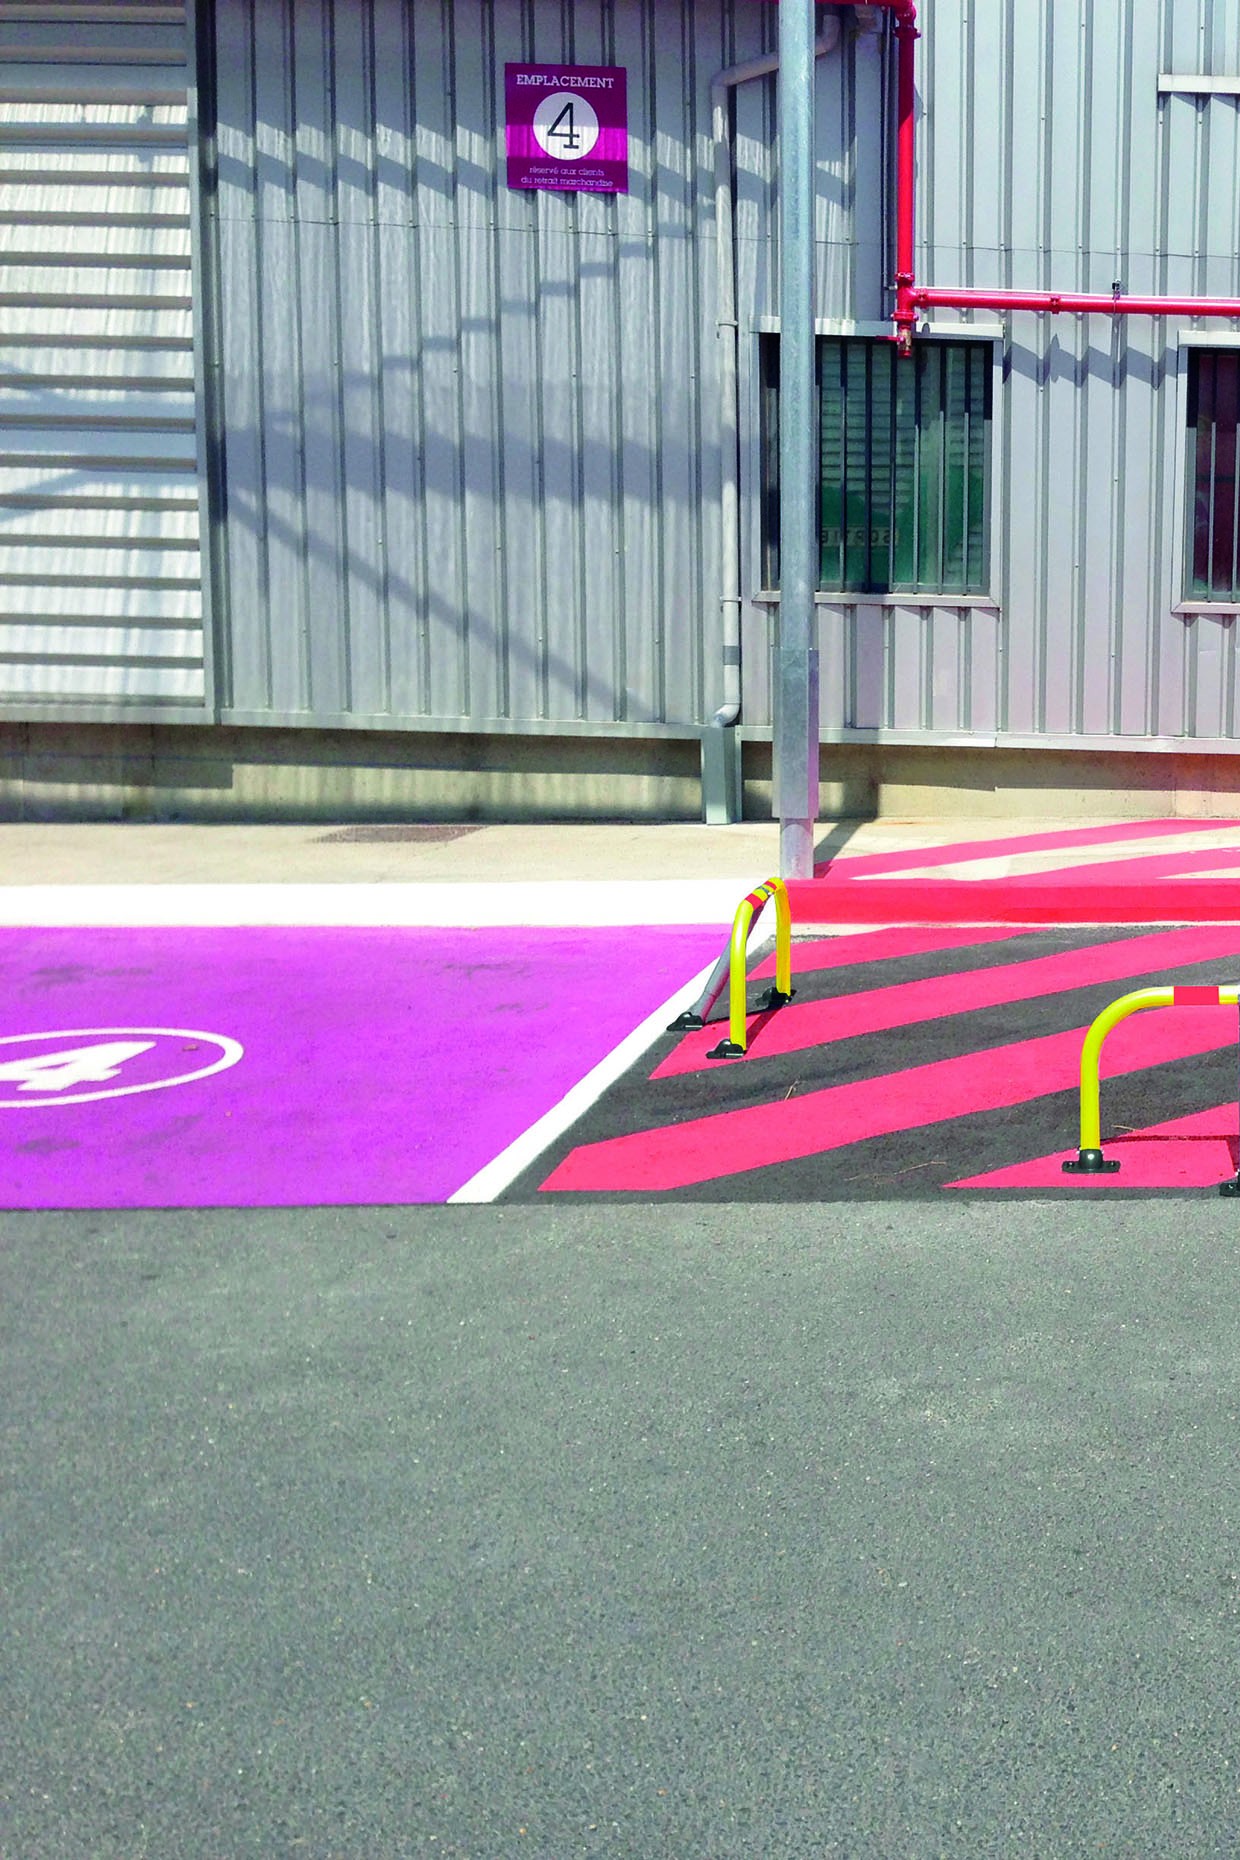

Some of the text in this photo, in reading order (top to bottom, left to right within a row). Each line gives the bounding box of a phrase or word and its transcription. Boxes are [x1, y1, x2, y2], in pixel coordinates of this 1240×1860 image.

[516, 74, 614, 89] EMPLACEMENT
[547, 102, 580, 149] 4
[560, 168, 577, 176] aux
[578, 169, 604, 177] clients
[521, 176, 613, 187] du retrait marchandise
